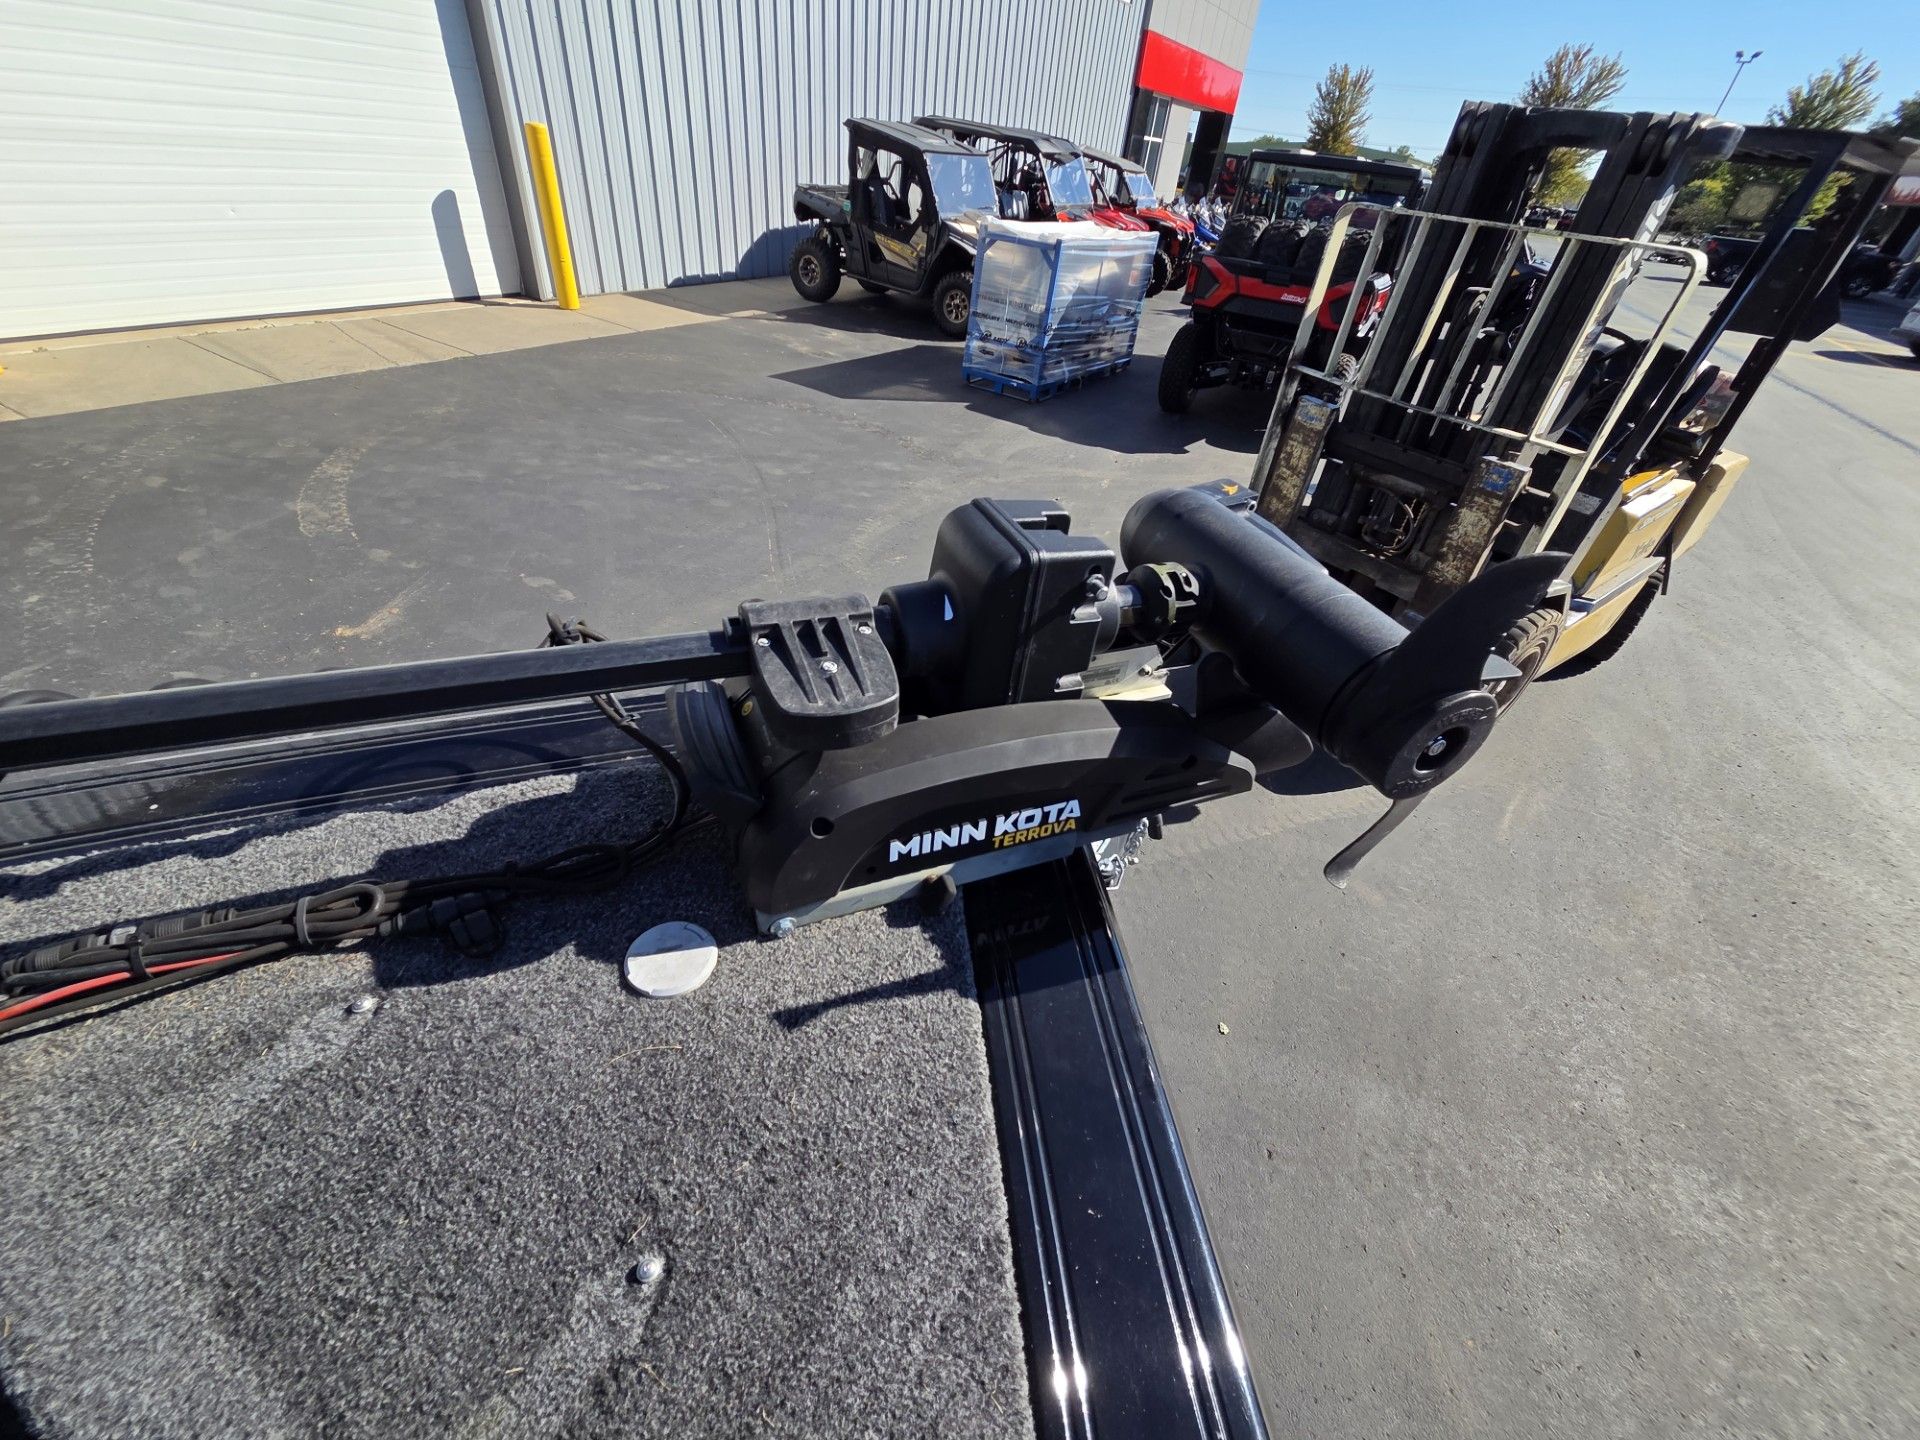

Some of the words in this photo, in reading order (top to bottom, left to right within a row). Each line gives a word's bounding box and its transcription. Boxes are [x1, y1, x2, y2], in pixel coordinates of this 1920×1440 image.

[889, 818, 987, 862] MINN
[994, 799, 1081, 836] KOTA
[992, 818, 1076, 849] TERROVA
